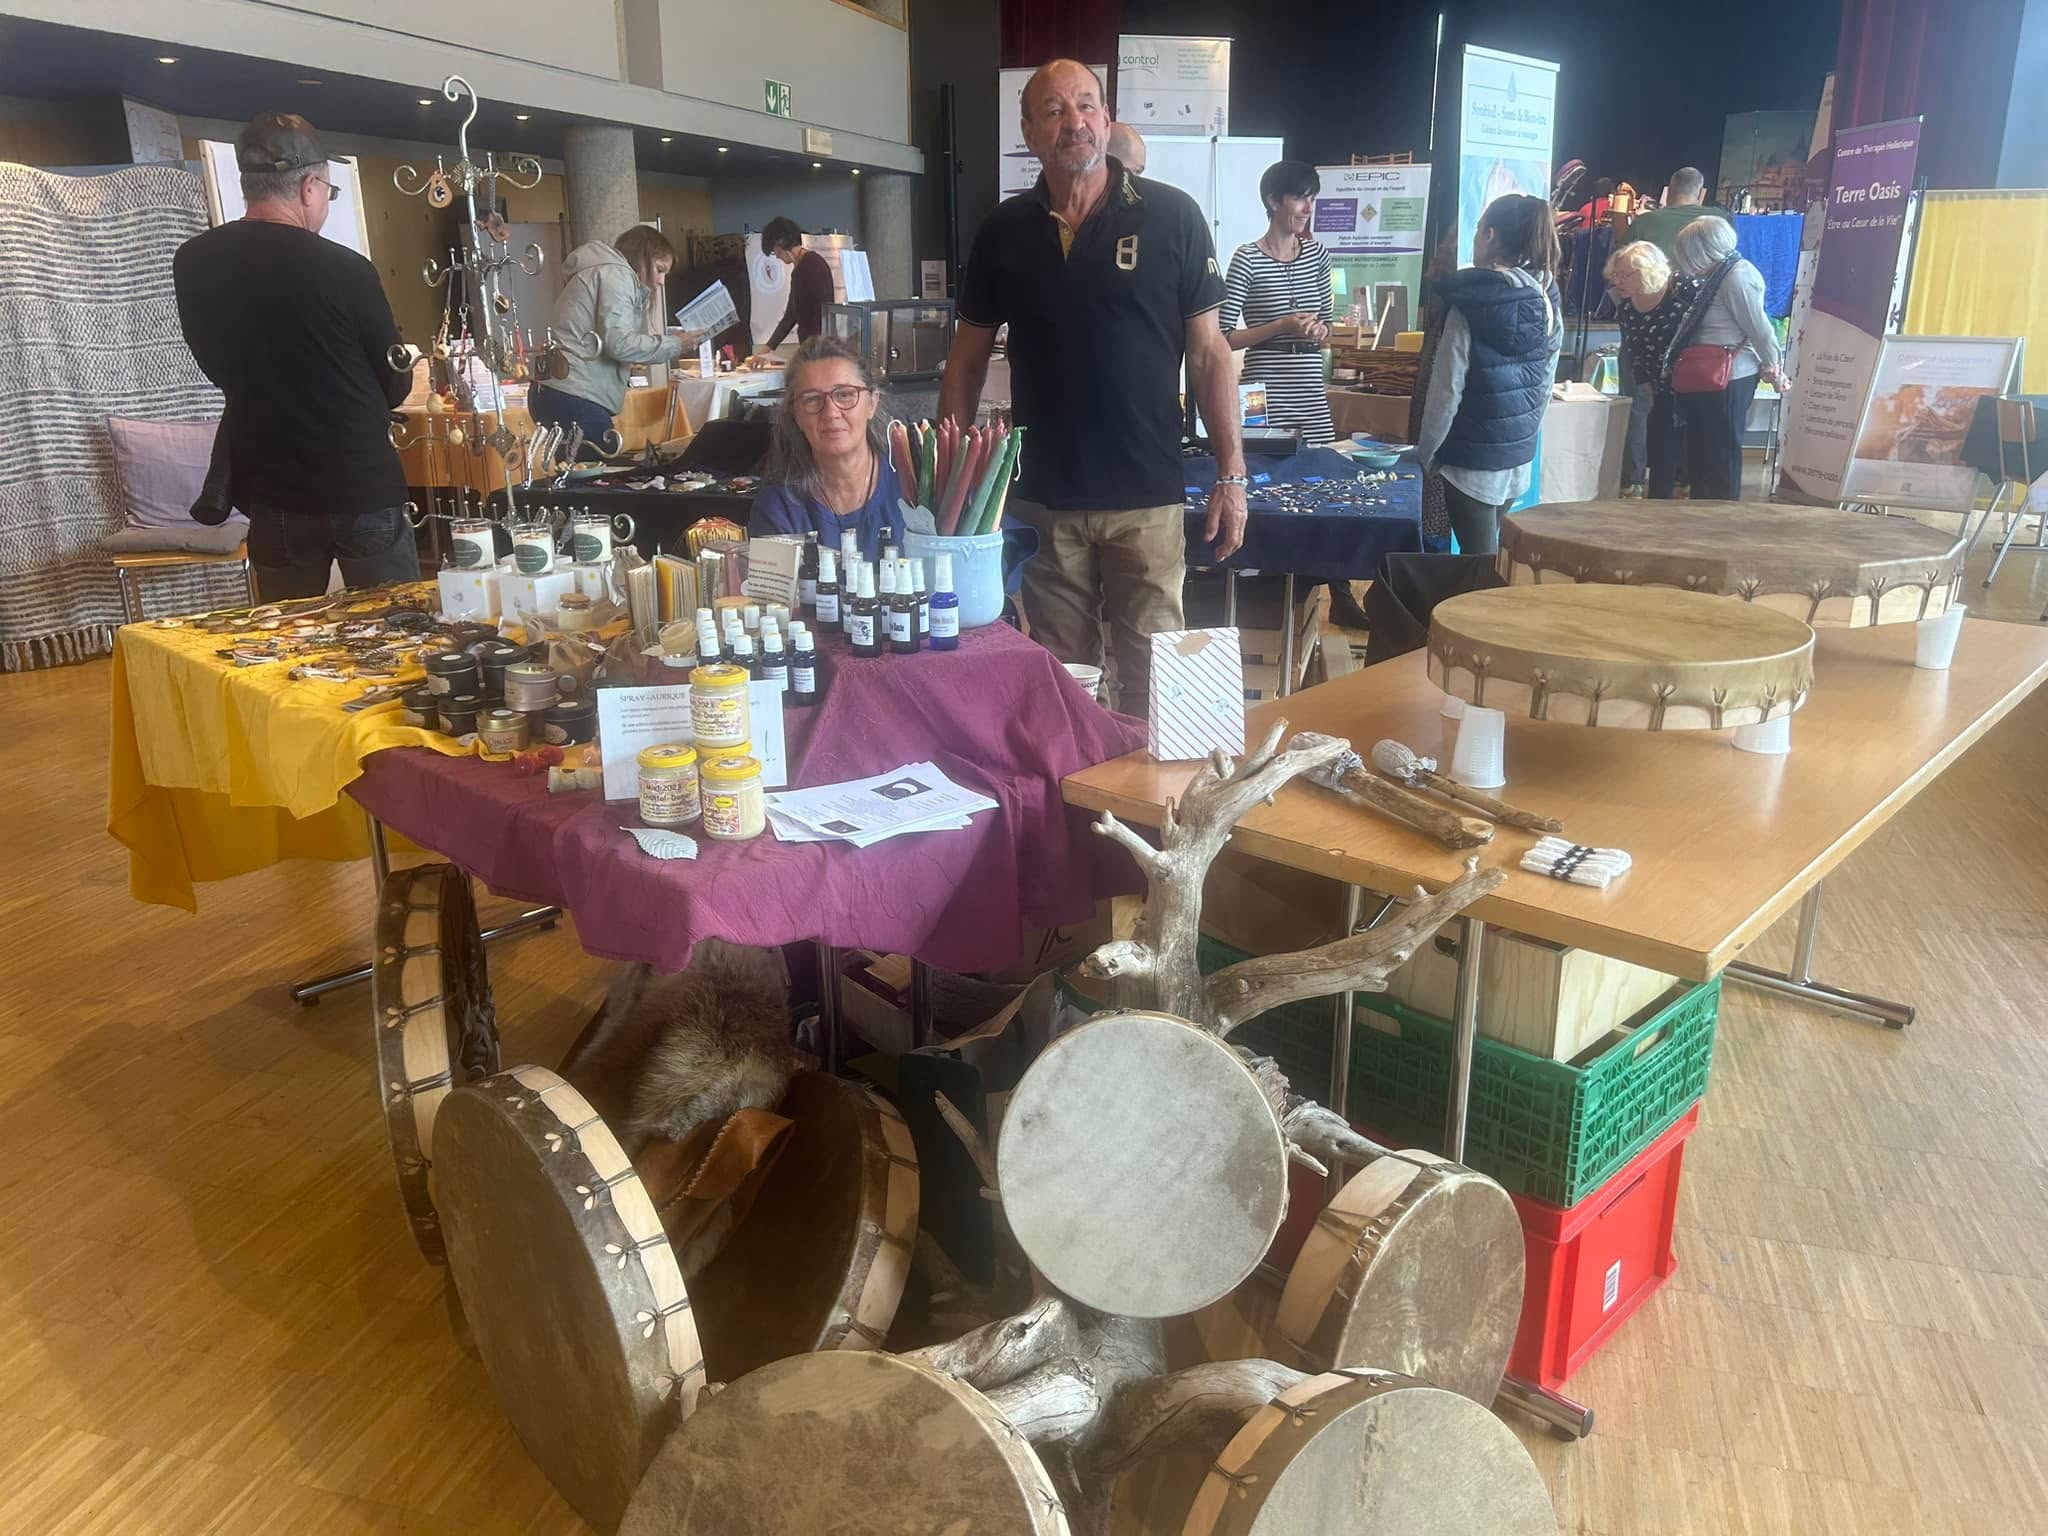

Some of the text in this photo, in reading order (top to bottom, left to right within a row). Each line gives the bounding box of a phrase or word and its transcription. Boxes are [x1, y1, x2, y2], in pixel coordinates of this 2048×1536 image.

[1122, 55, 1159, 65] control
[1855, 146, 1862, 155] de
[1355, 172, 1401, 181] EPIC
[1835, 180, 1901, 204] Terre Oasis
